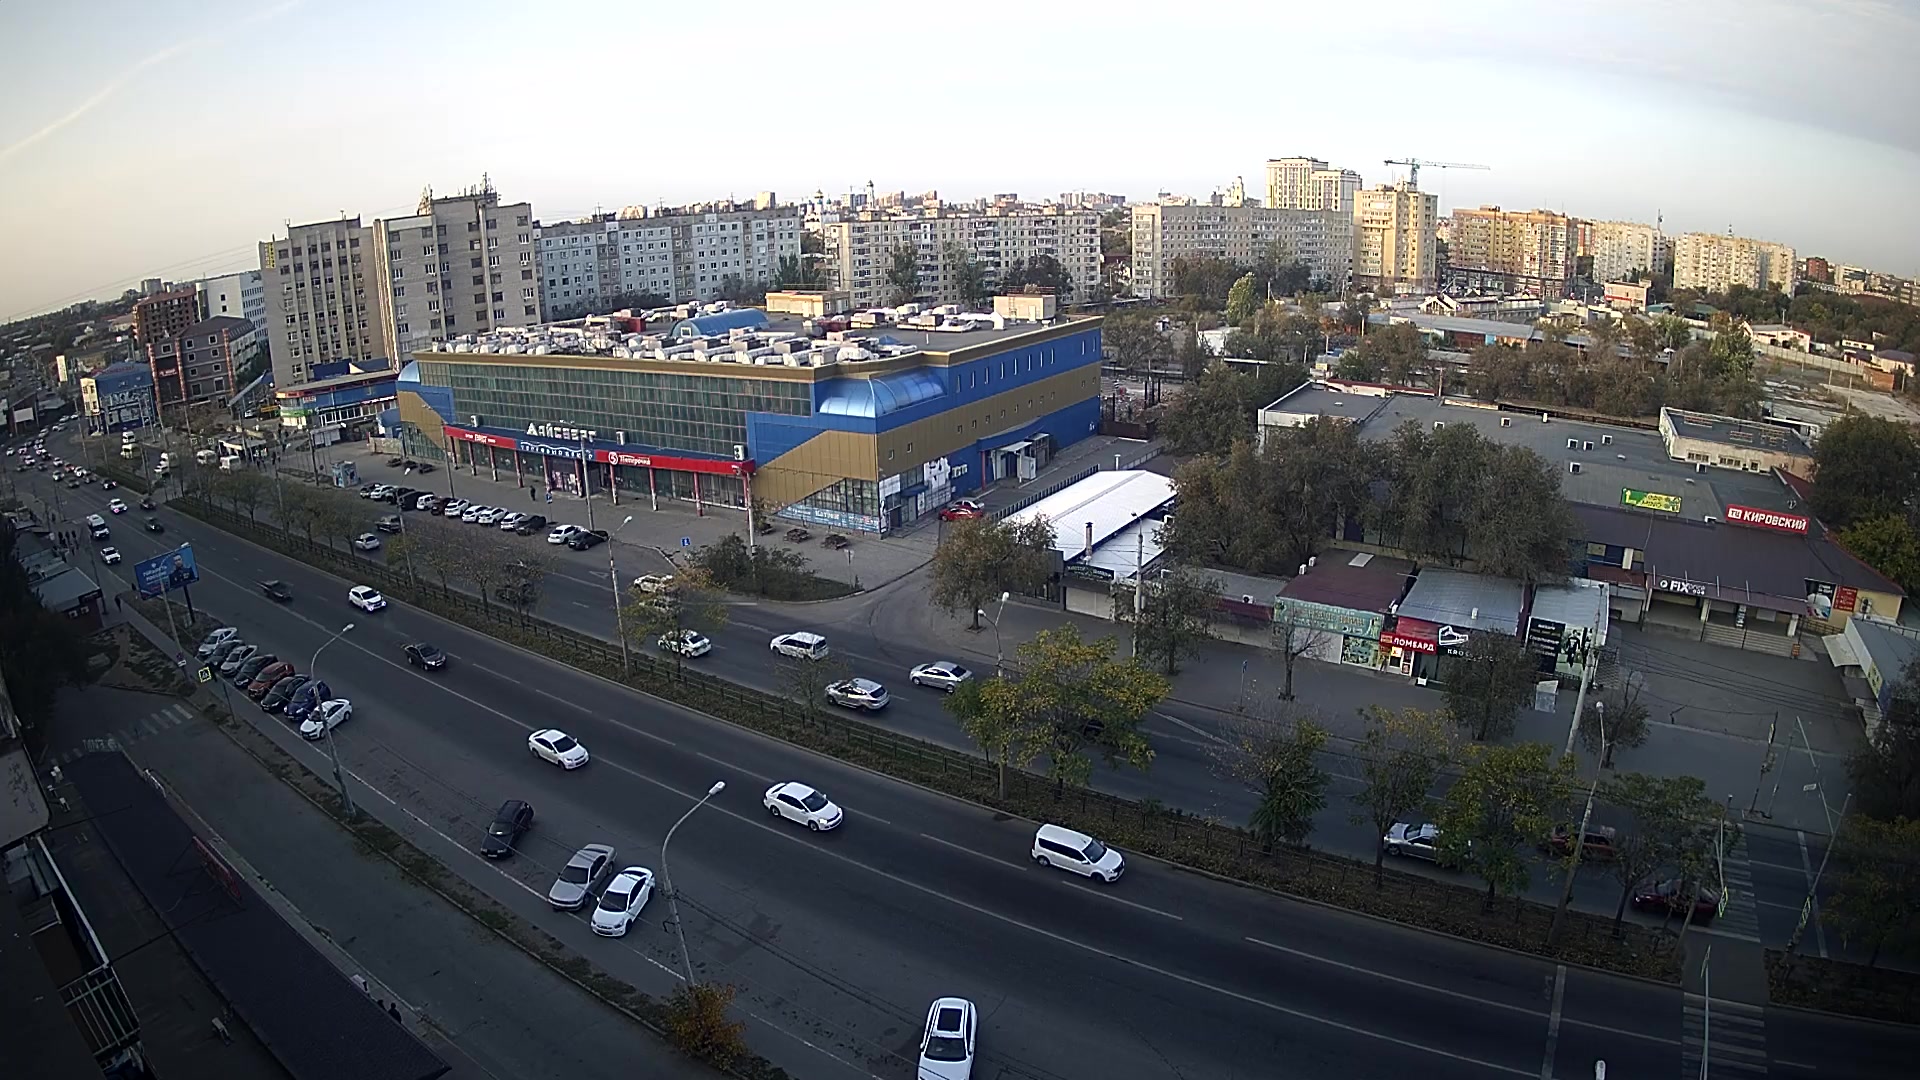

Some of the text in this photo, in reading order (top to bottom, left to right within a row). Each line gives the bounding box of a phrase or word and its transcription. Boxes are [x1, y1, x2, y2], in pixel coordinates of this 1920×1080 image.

[1744, 510, 1807, 531] КИРОВСКИЙ
[1670, 581, 1689, 593] FIX
[1393, 637, 1434, 651] ЛОМБАРД
